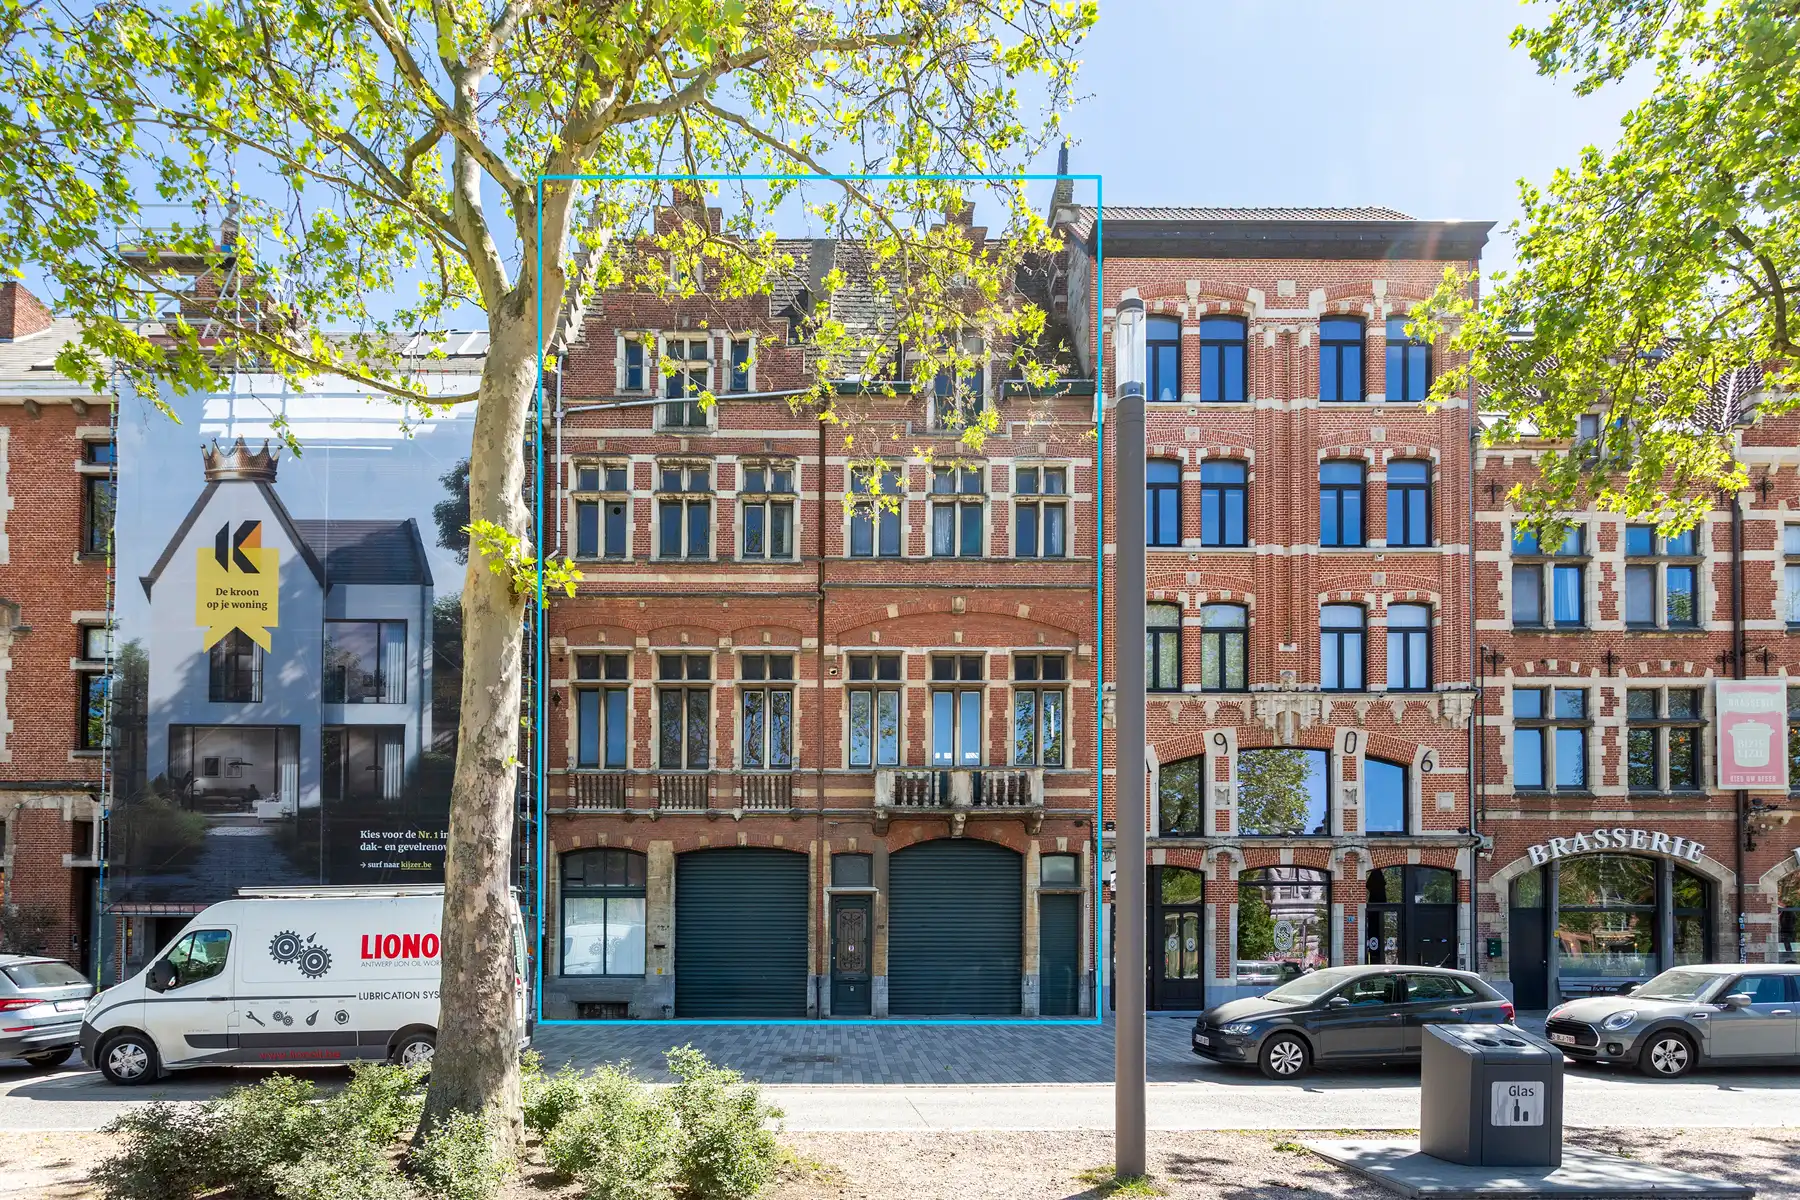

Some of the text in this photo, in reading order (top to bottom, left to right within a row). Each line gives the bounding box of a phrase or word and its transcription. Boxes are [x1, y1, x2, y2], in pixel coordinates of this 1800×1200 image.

[216, 587, 259, 596] De kroon
[206, 600, 268, 611] op je woning
[360, 830, 381, 839] Kies
[382, 831, 404, 839] voor
[405, 830, 417, 839] de
[418, 830, 433, 839] Nr.
[434, 831, 439, 839] 1
[360, 842, 383, 851] dak-
[1527, 828, 1706, 867] BRASSERIE
[367, 861, 383, 869] surf
[400, 861, 432, 870] kijzer.be
[361, 933, 443, 960] LIONO
[358, 990, 440, 1000] LUBRICATION SYS
[259, 1049, 341, 1060] www.lionoil.be
[1508, 1085, 1535, 1097] Glas
